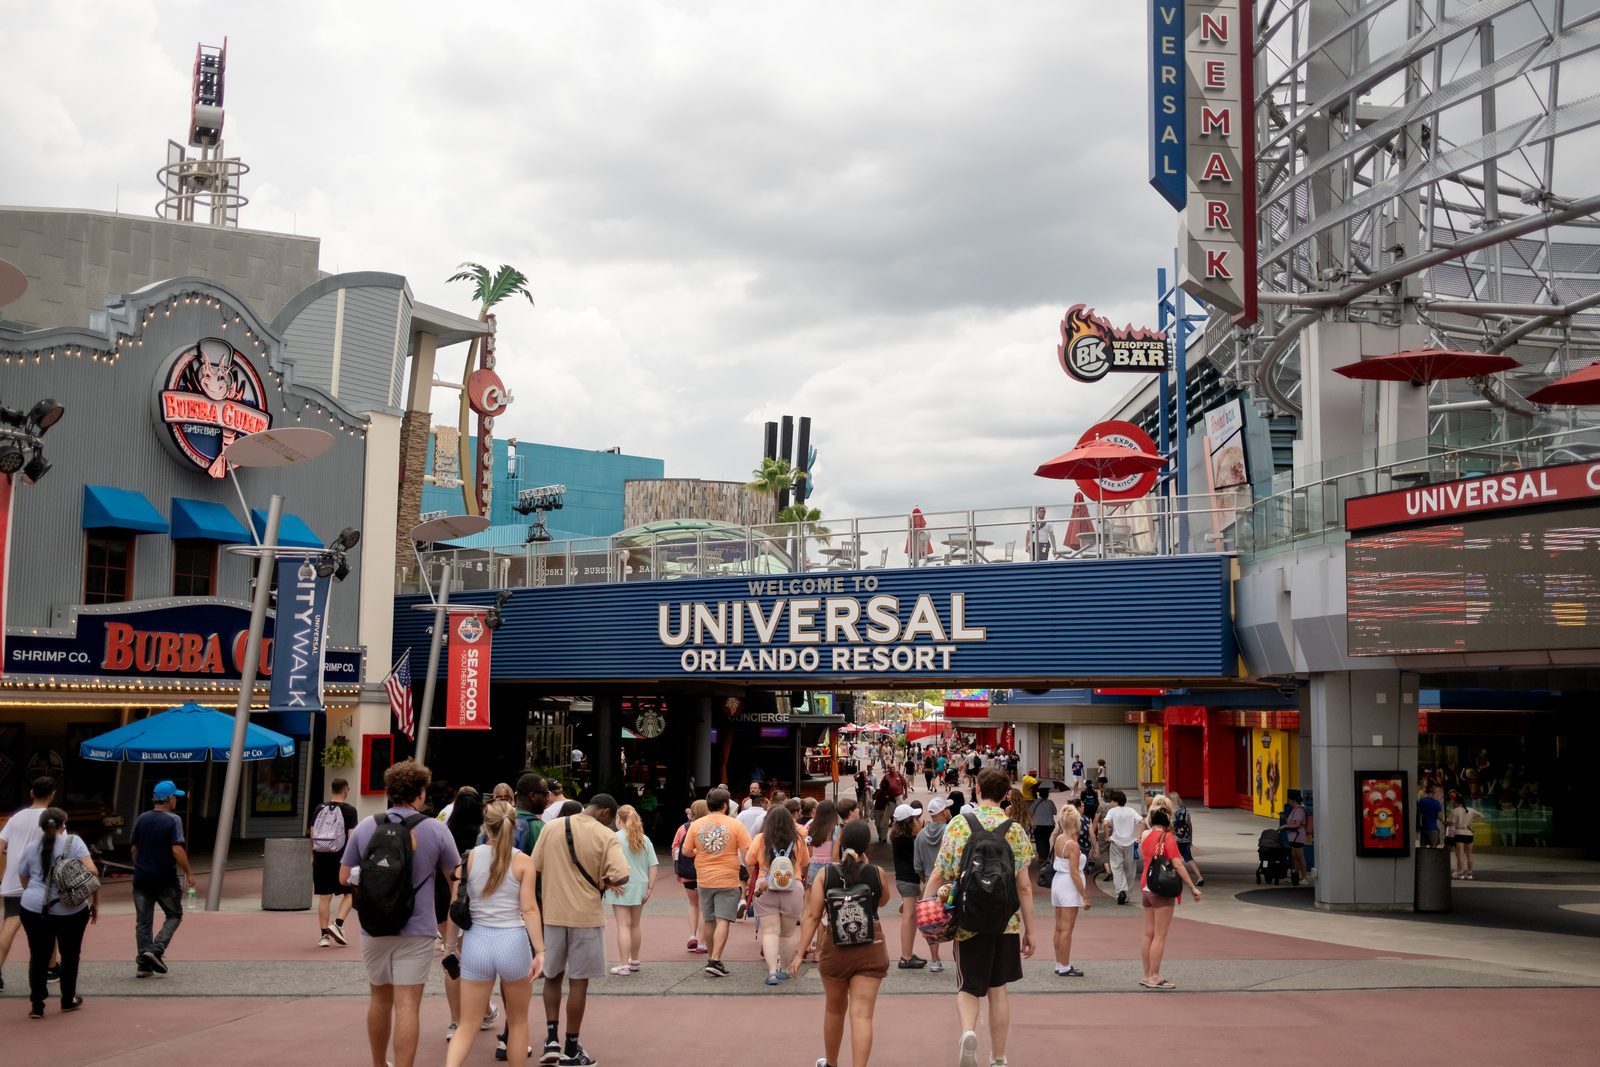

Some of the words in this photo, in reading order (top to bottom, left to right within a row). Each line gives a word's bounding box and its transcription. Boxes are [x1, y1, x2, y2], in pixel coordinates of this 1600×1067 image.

[1076, 341, 1107, 368] BK
[1112, 341, 1164, 350] WHOPPER
[1113, 351, 1165, 366] BAR
[164, 393, 219, 423] BUBBA
[182, 424, 220, 437] SHRIMP
[1113, 437, 1138, 450] EXPR
[1117, 473, 1139, 488] KITCHE
[1405, 471, 1558, 515] UNIVERSAL
[747, 577, 844, 597] WELCOME
[852, 575, 879, 592] TO
[658, 592, 987, 648] UNIVERSAL
[312, 614, 321, 656] UNIVERSAL
[12, 649, 67, 662] SHRIMP
[68, 652, 91, 663] CO.
[101, 621, 226, 674] BUBBA
[680, 646, 820, 673] ORLANDO
[831, 644, 957, 672] RESORT
[324, 662, 342, 672] RIMP
[342, 663, 355, 673] CO.
[466, 648, 479, 721] SEAFOOD
[142, 752, 168, 760] BUBBA
[169, 751, 193, 760] GUMP
